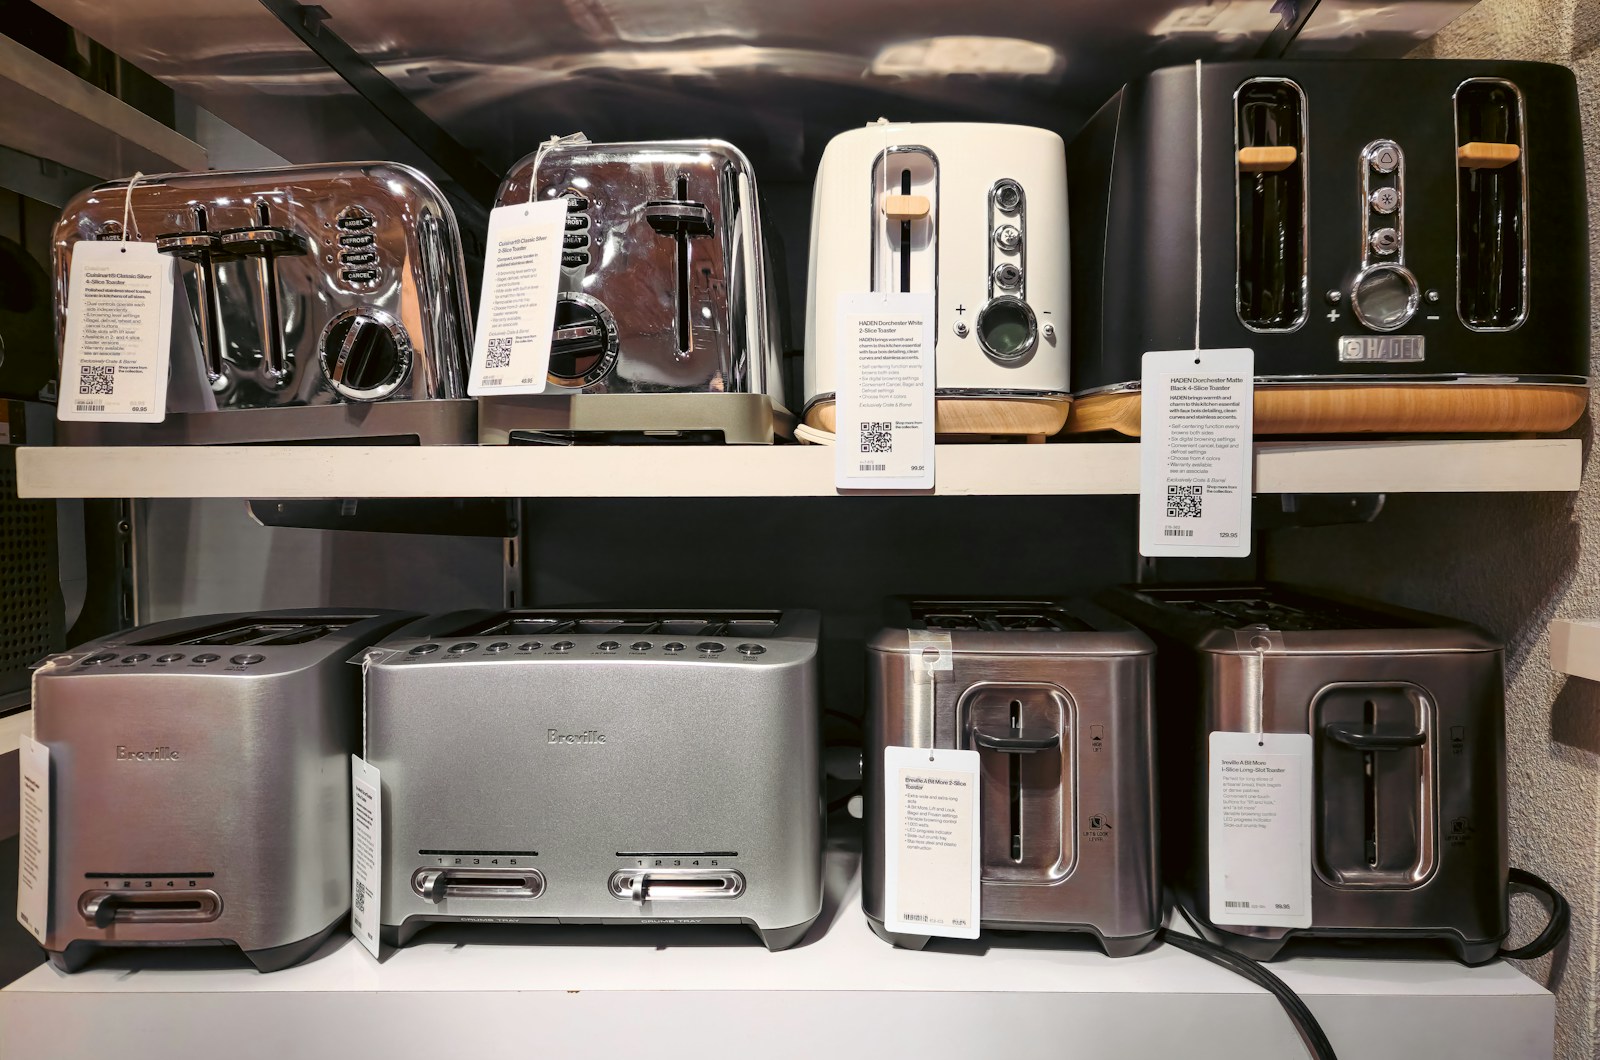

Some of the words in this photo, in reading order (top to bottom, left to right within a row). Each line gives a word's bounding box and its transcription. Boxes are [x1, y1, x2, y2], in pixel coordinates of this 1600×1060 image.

[1367, 337, 1423, 359] HADEN
[547, 729, 607, 744] Breville
[116, 746, 180, 761] Breville
